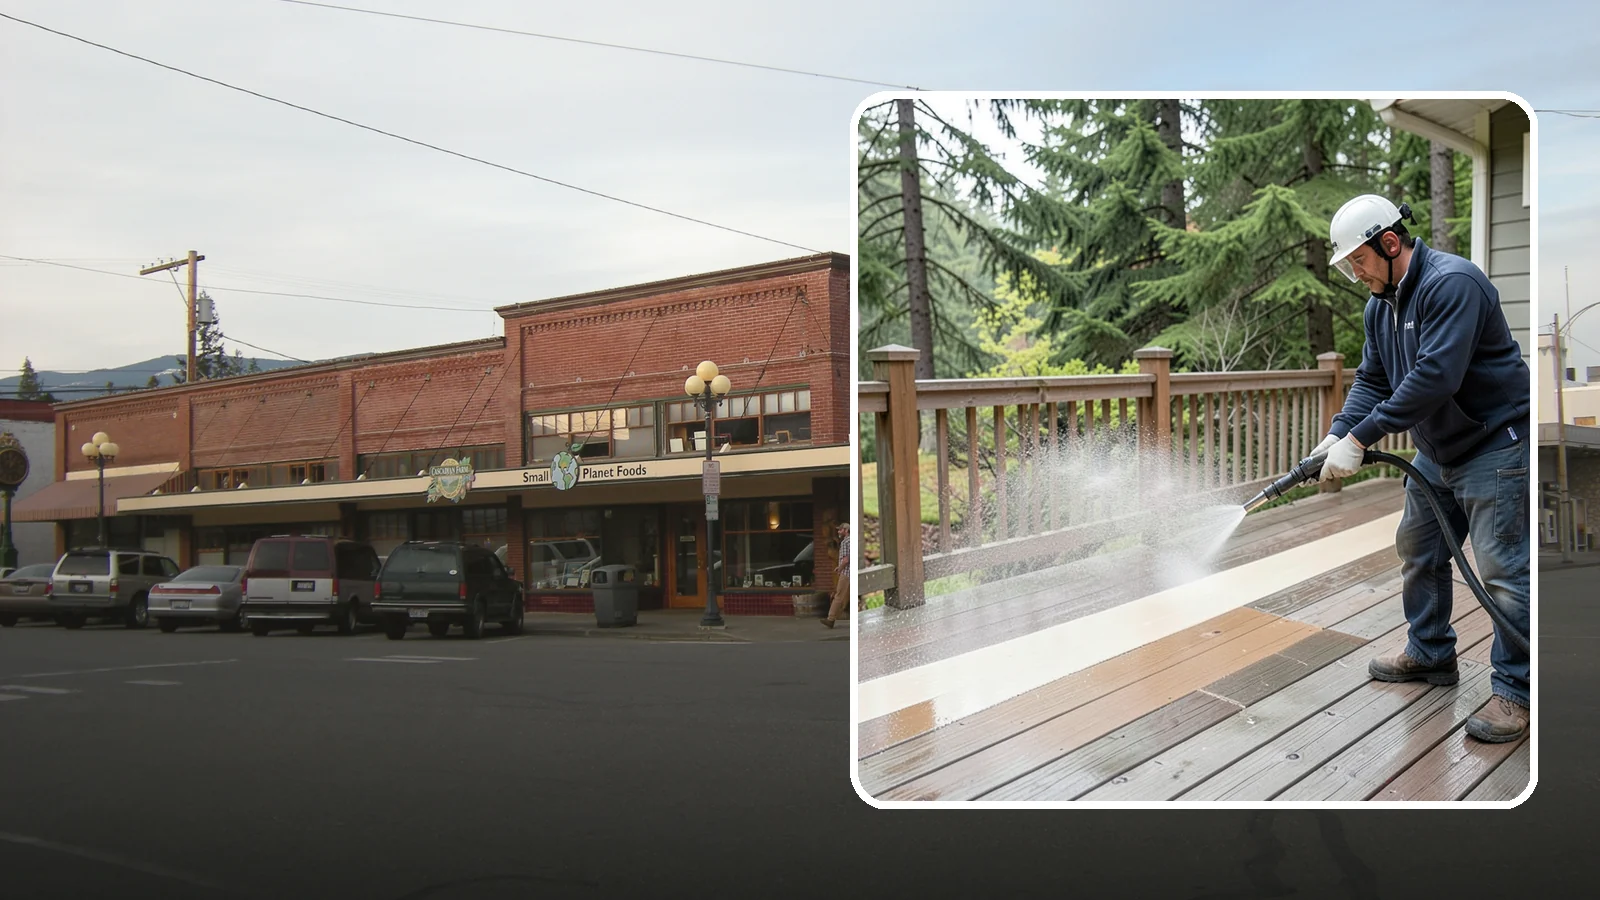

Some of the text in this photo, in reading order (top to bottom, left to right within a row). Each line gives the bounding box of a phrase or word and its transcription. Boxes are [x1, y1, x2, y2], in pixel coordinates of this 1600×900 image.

[522, 464, 647, 483] Small Planet Foods
